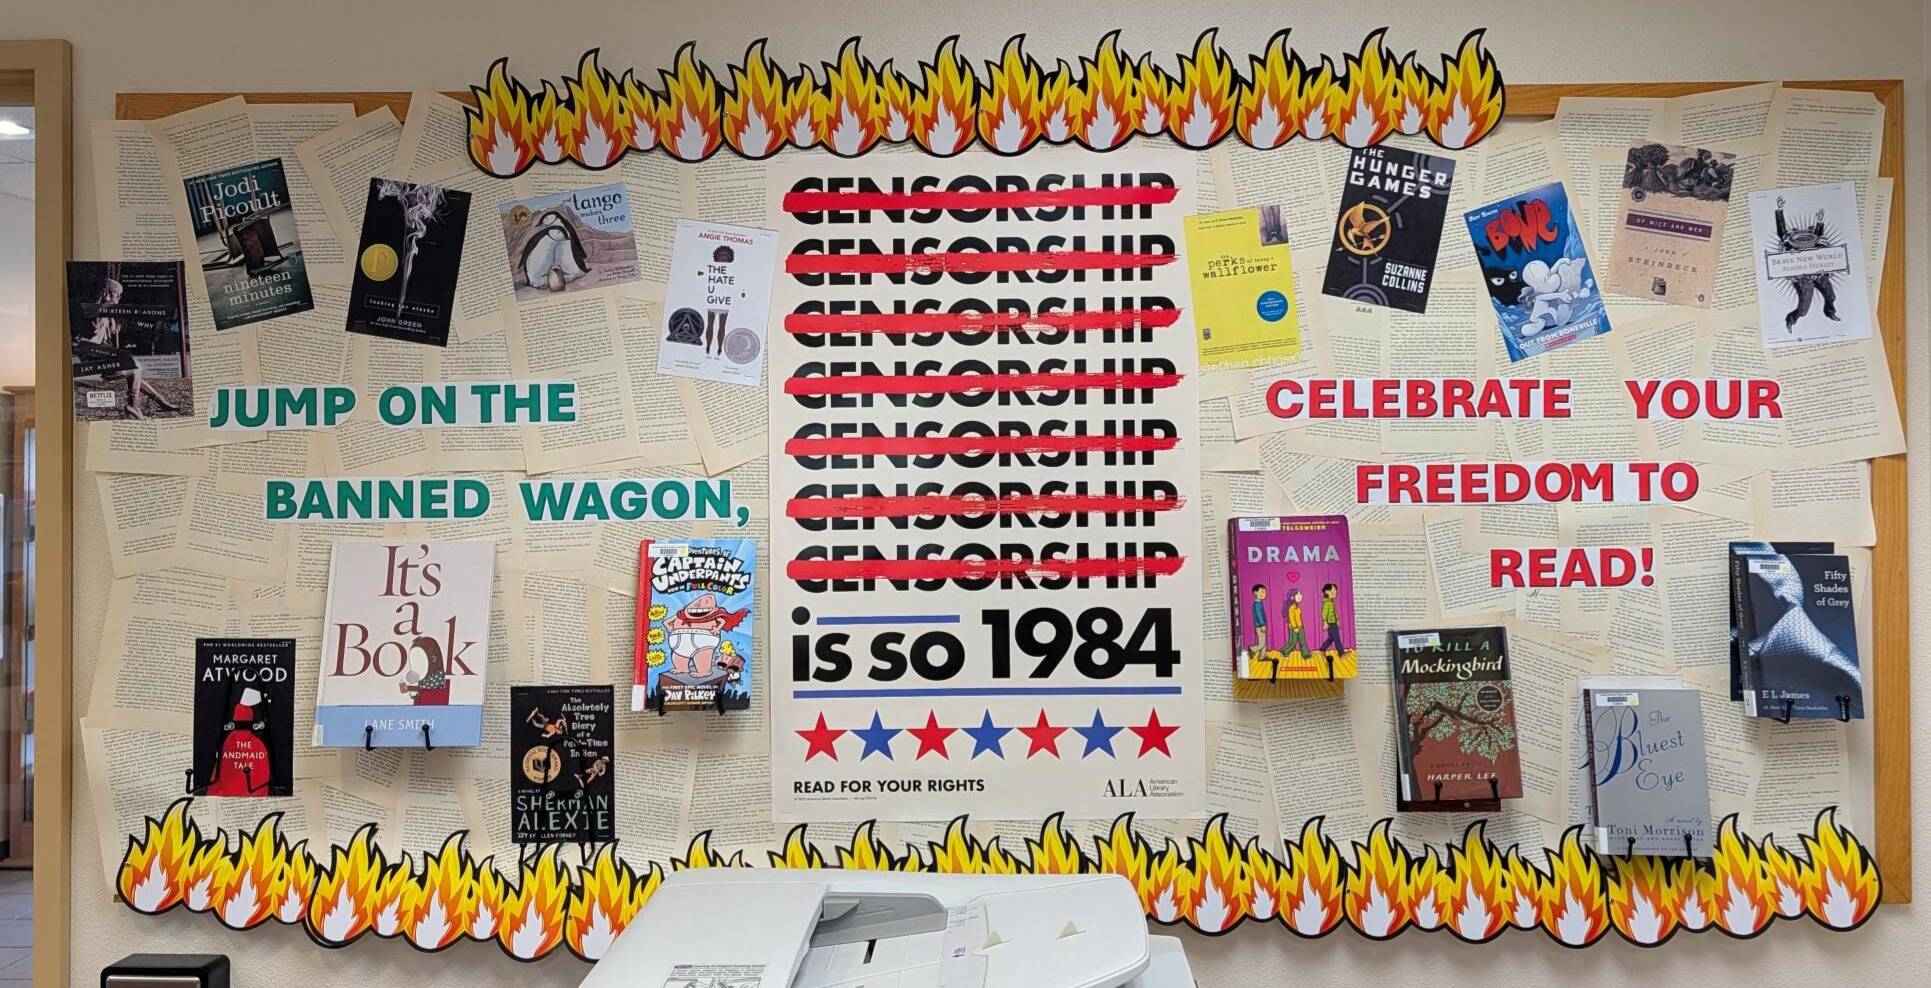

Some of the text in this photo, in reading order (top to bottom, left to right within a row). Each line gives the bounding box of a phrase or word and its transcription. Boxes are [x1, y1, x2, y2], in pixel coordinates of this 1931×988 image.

[1353, 155, 1448, 186] HUNGER
[213, 175, 261, 200] Jodi
[1350, 171, 1433, 199] GAMES
[573, 193, 622, 211] tango
[790, 172, 1175, 225] CENSORSHIP
[200, 191, 281, 223] Picoult
[580, 210, 603, 218] makes
[598, 214, 626, 226] three
[1649, 220, 1668, 228] MICE
[1671, 223, 1685, 231] AND
[1688, 226, 1703, 234] MEN
[698, 232, 720, 241] ANGIE
[723, 235, 754, 246] THOMAS
[1654, 247, 1676, 255] JOHN
[791, 234, 1176, 286] CENSORSHIP
[1208, 256, 1246, 270] perks
[1254, 256, 1270, 264] being
[1628, 257, 1698, 273] STEINBECK
[707, 265, 727, 275] THE
[1203, 262, 1278, 279] wallflower
[1384, 262, 1428, 282] SUZANNE
[224, 270, 292, 294] nineteen
[708, 276, 735, 286] HATE
[1382, 274, 1426, 294] COLLINS
[230, 283, 293, 306] minutes
[708, 286, 715, 294] U
[707, 295, 731, 305] GIVE
[412, 306, 434, 314] alaska
[137, 321, 154, 329] WHY
[376, 316, 422, 328] JOHN GREEN
[791, 296, 1177, 348] CENSORSHIP
[1519, 336, 1536, 349] OUT
[1536, 331, 1558, 346] FROM
[1559, 318, 1598, 337] BONEVILLE
[81, 362, 121, 373] JAY ASHER
[791, 357, 1177, 409] CENSORSHIP
[209, 383, 575, 428] JUMP ON THE
[1267, 377, 1783, 420] CELEBRATE YOUR
[791, 419, 1177, 471] CENSORSHIP
[1357, 462, 1699, 503] FREEDOM TO
[266, 480, 750, 528] BANNED WAGON,
[792, 480, 1178, 532] CENSORSHIP
[1247, 545, 1340, 563] DRAMA
[378, 544, 441, 597] It's
[652, 556, 742, 576] CAPTAIN
[792, 541, 1179, 593] CENSORSHIP
[1490, 547, 1654, 588] READ!
[651, 569, 750, 593] UNDERPANTS
[1824, 570, 1847, 581] Fifty
[685, 582, 708, 592] FULL
[707, 582, 735, 596] COLOR
[1814, 584, 1848, 593] Shades
[1827, 599, 1850, 608] Grey
[393, 601, 423, 636] a
[328, 616, 478, 677] Bok
[792, 606, 1181, 682] is so 1984
[1432, 641, 1473, 653] KILL
[1481, 640, 1490, 650] A
[213, 654, 278, 664] MARGARET
[202, 667, 288, 682] ATWOOD
[1401, 656, 1503, 680] Mockingbird
[664, 690, 682, 701] DAV
[1762, 691, 1810, 699] E L James
[562, 703, 610, 712] Absolutely
[364, 719, 435, 730] LANE SMITH
[574, 712, 595, 721] True
[1650, 710, 1671, 725] The
[572, 722, 596, 732] Diary
[236, 741, 252, 749] THE
[1594, 706, 1685, 787] Bluest
[571, 749, 597, 758] Inian
[1427, 772, 1497, 781] HARPER LEE
[1635, 759, 1685, 791] Eye
[793, 779, 985, 793] READ FOR YOUR RIGHTS
[1102, 778, 1149, 797] ALA
[1607, 824, 1704, 836] Toni Morrison
